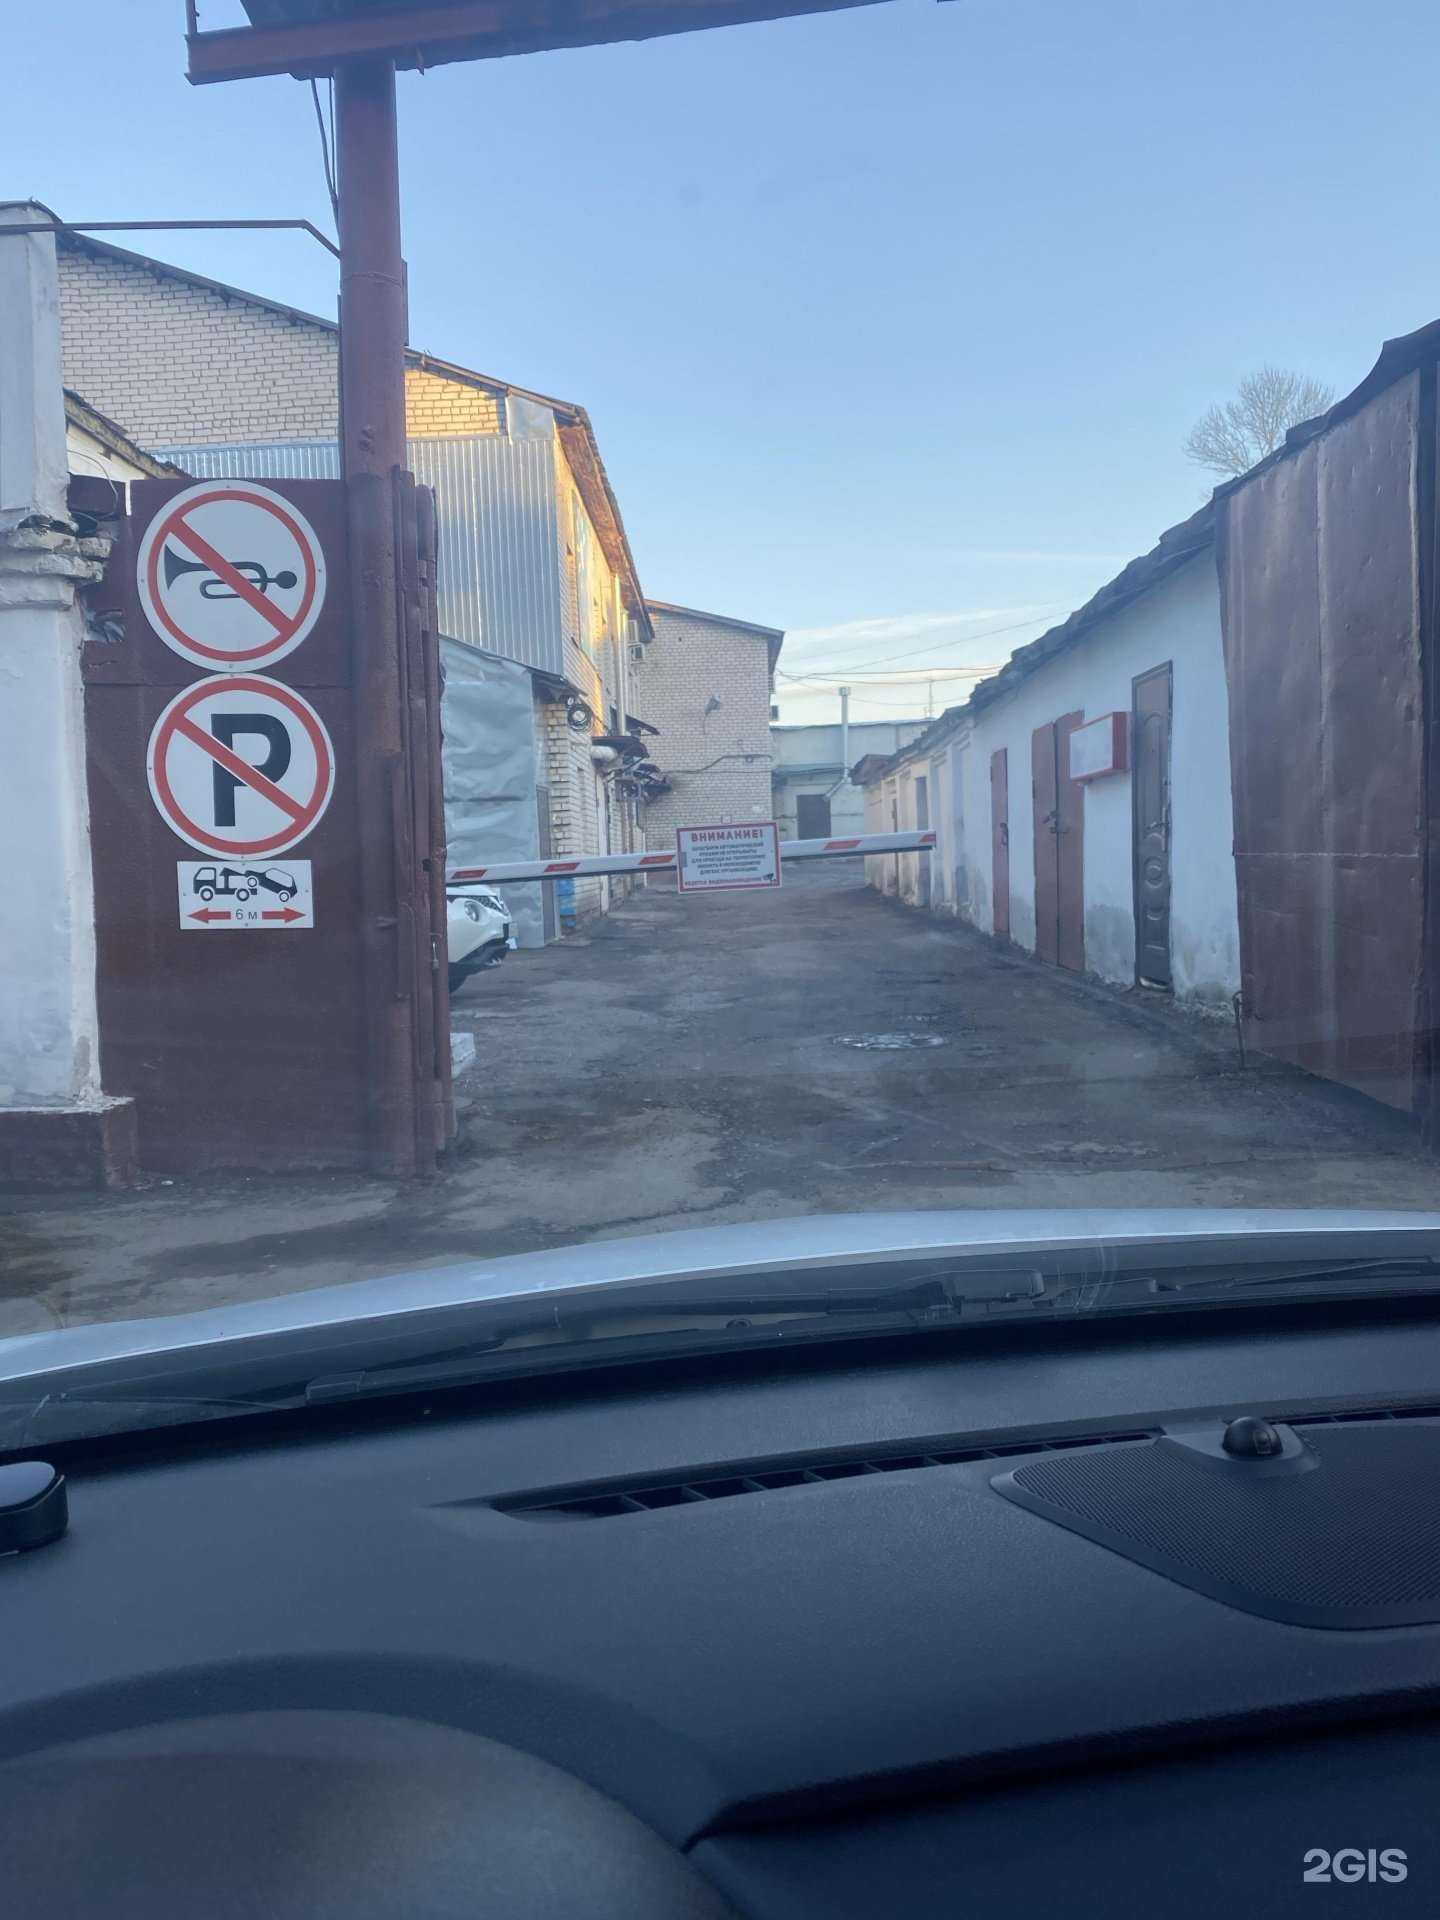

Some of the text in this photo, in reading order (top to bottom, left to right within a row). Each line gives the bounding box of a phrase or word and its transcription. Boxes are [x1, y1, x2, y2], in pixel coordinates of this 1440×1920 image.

[211, 713, 291, 827] P
[691, 829, 764, 842] ВНИМАНИЕ!
[235, 908, 244, 920] 6
